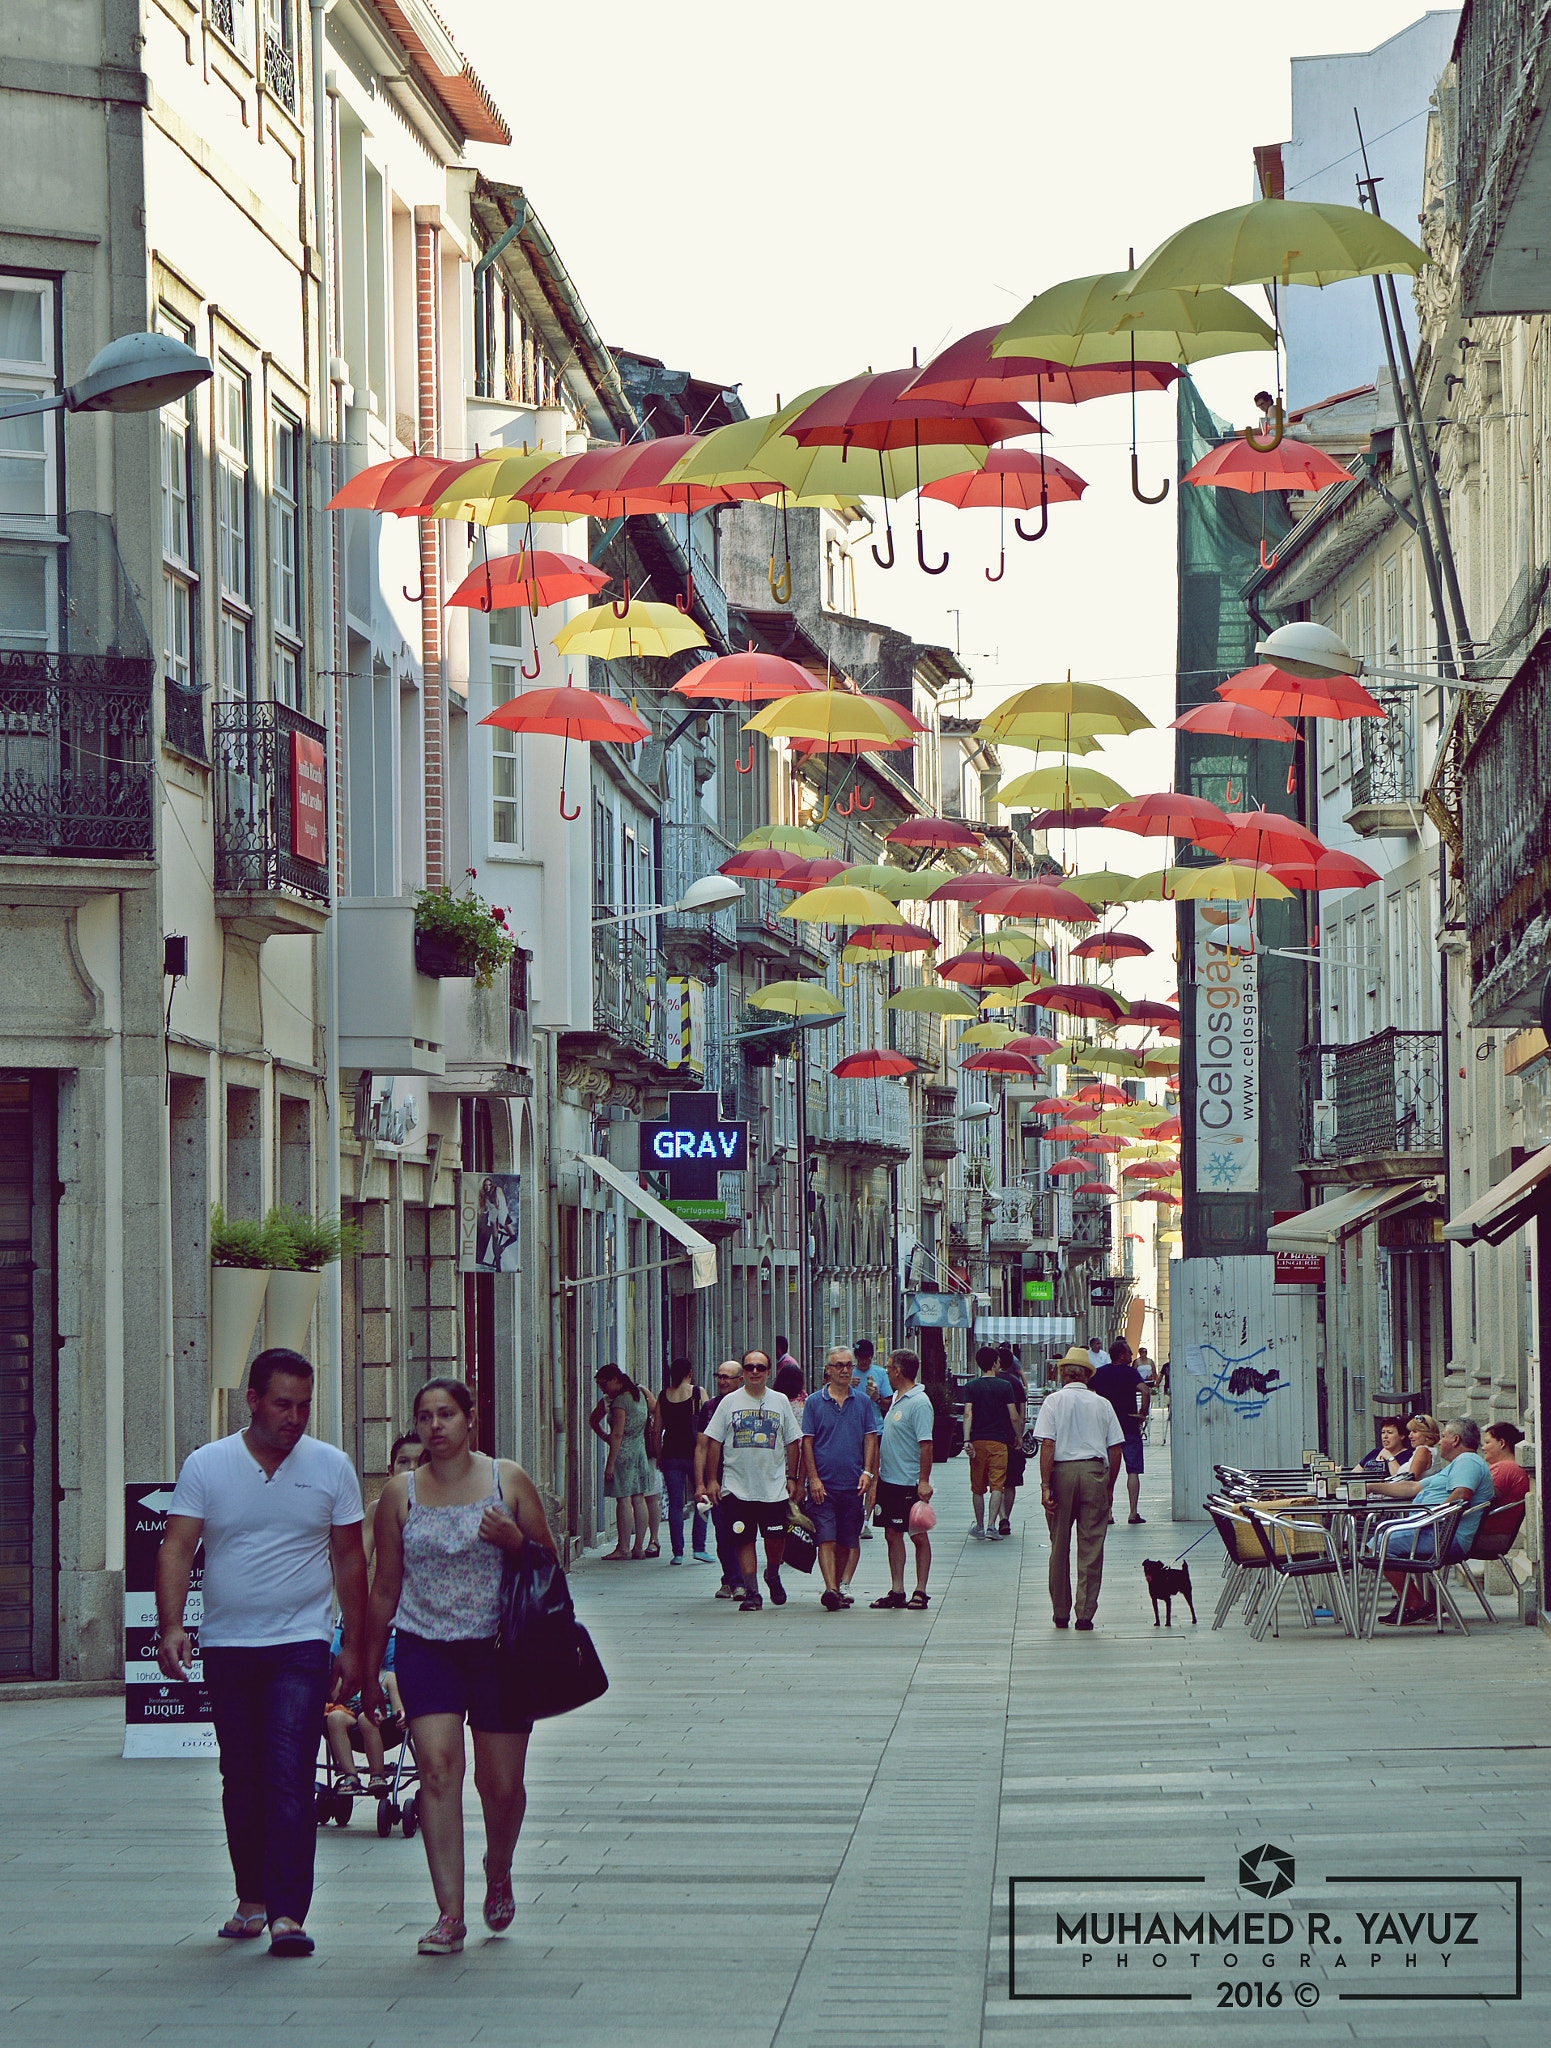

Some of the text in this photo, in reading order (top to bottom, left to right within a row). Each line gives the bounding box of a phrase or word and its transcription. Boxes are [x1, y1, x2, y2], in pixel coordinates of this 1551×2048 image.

[653, 1131, 738, 1158] GRAV
[676, 1206, 724, 1216] Portuguesas
[462, 1189, 476, 1256] LOVE
[144, 1704, 185, 1717] DUQUE
